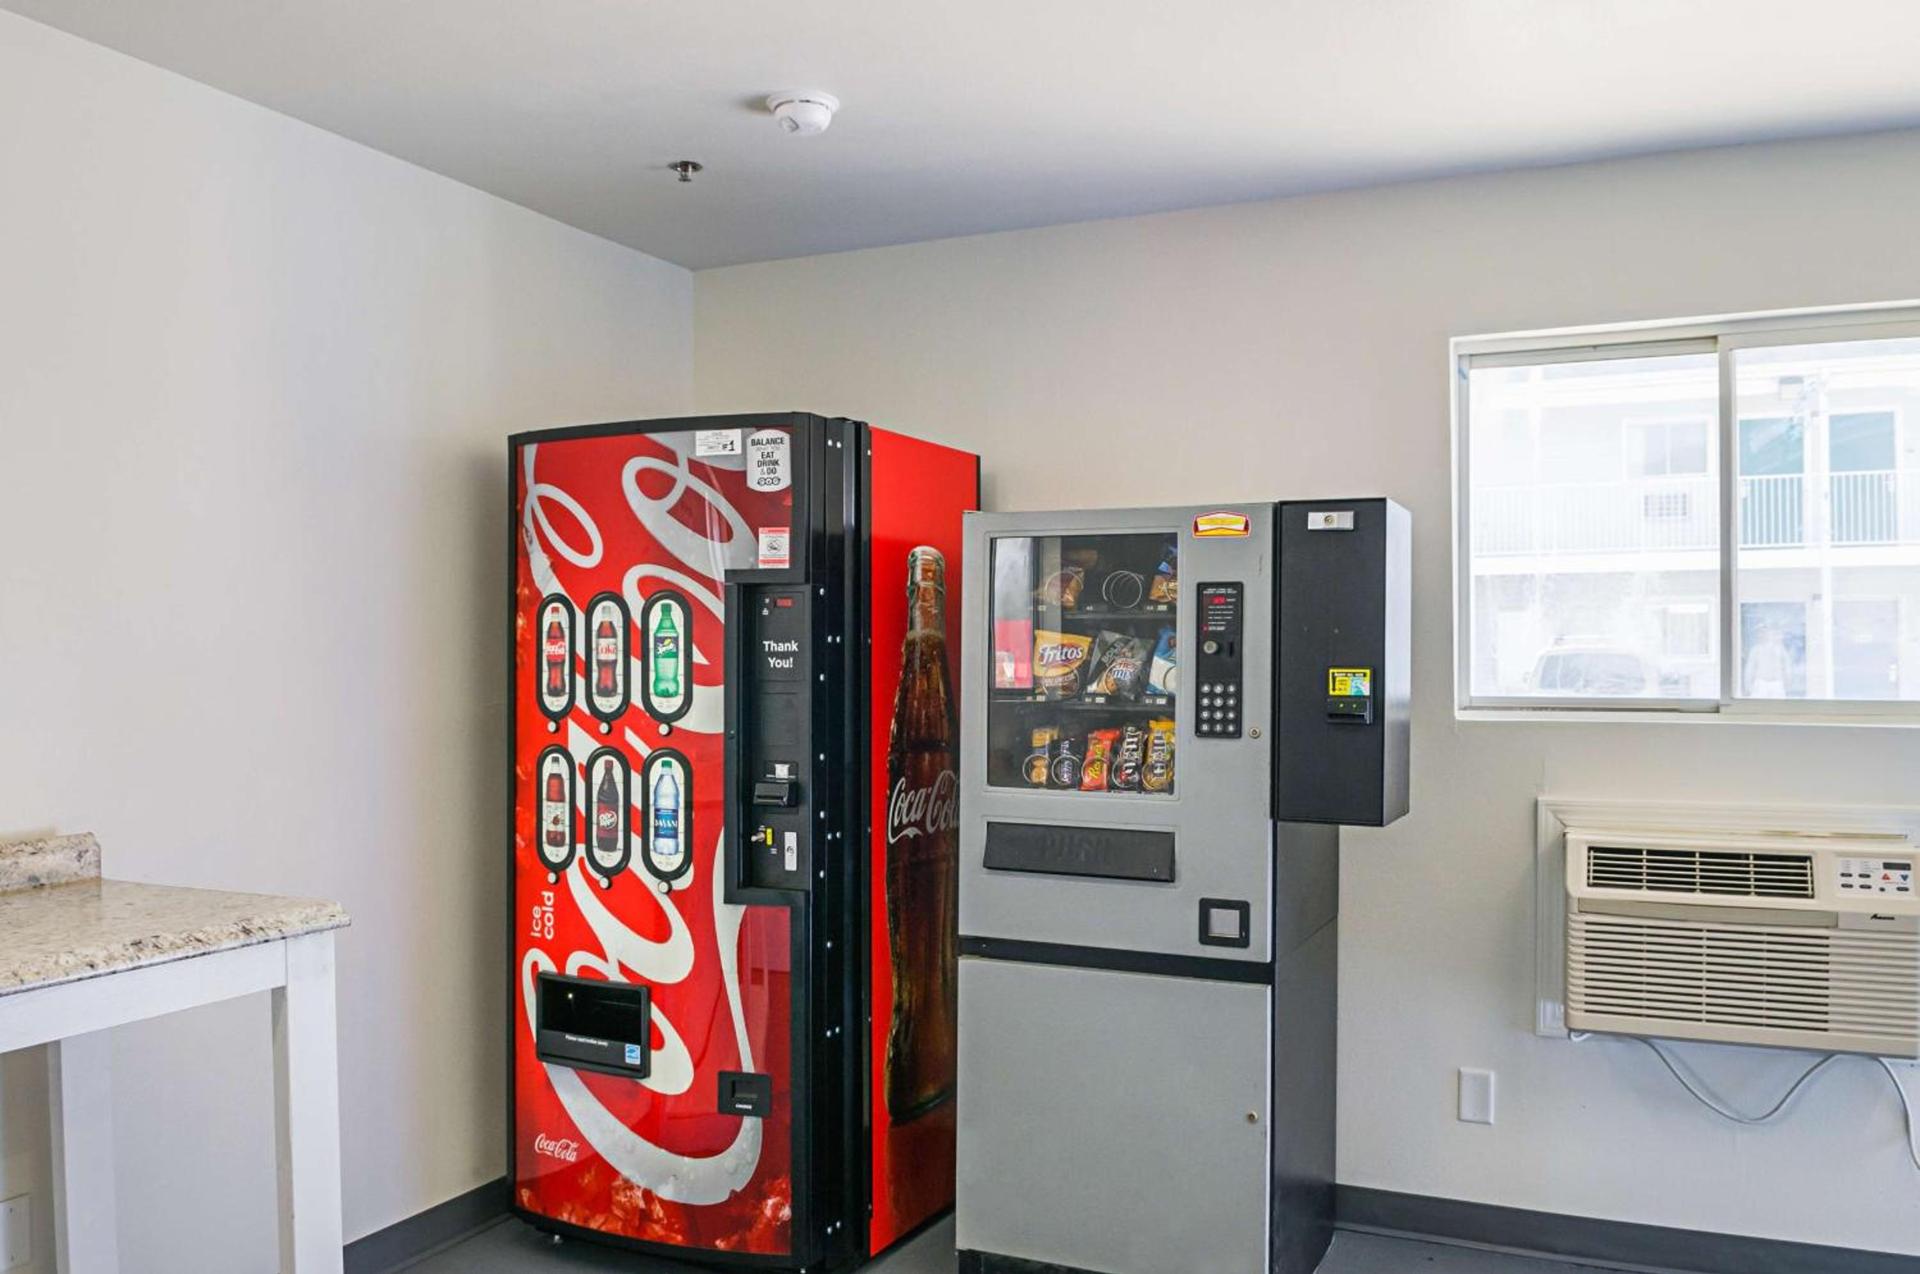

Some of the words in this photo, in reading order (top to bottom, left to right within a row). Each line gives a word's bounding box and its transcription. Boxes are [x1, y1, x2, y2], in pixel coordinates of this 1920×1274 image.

[751, 437, 784, 446] BALANCE
[761, 451, 774, 459] EAT
[757, 459, 780, 468] DRINK
[766, 466, 777, 475] DO
[762, 640, 799, 652] Thank
[768, 657, 793, 668] You!
[541, 891, 554, 940] cold
[534, 1133, 579, 1162] Coca-Cola
